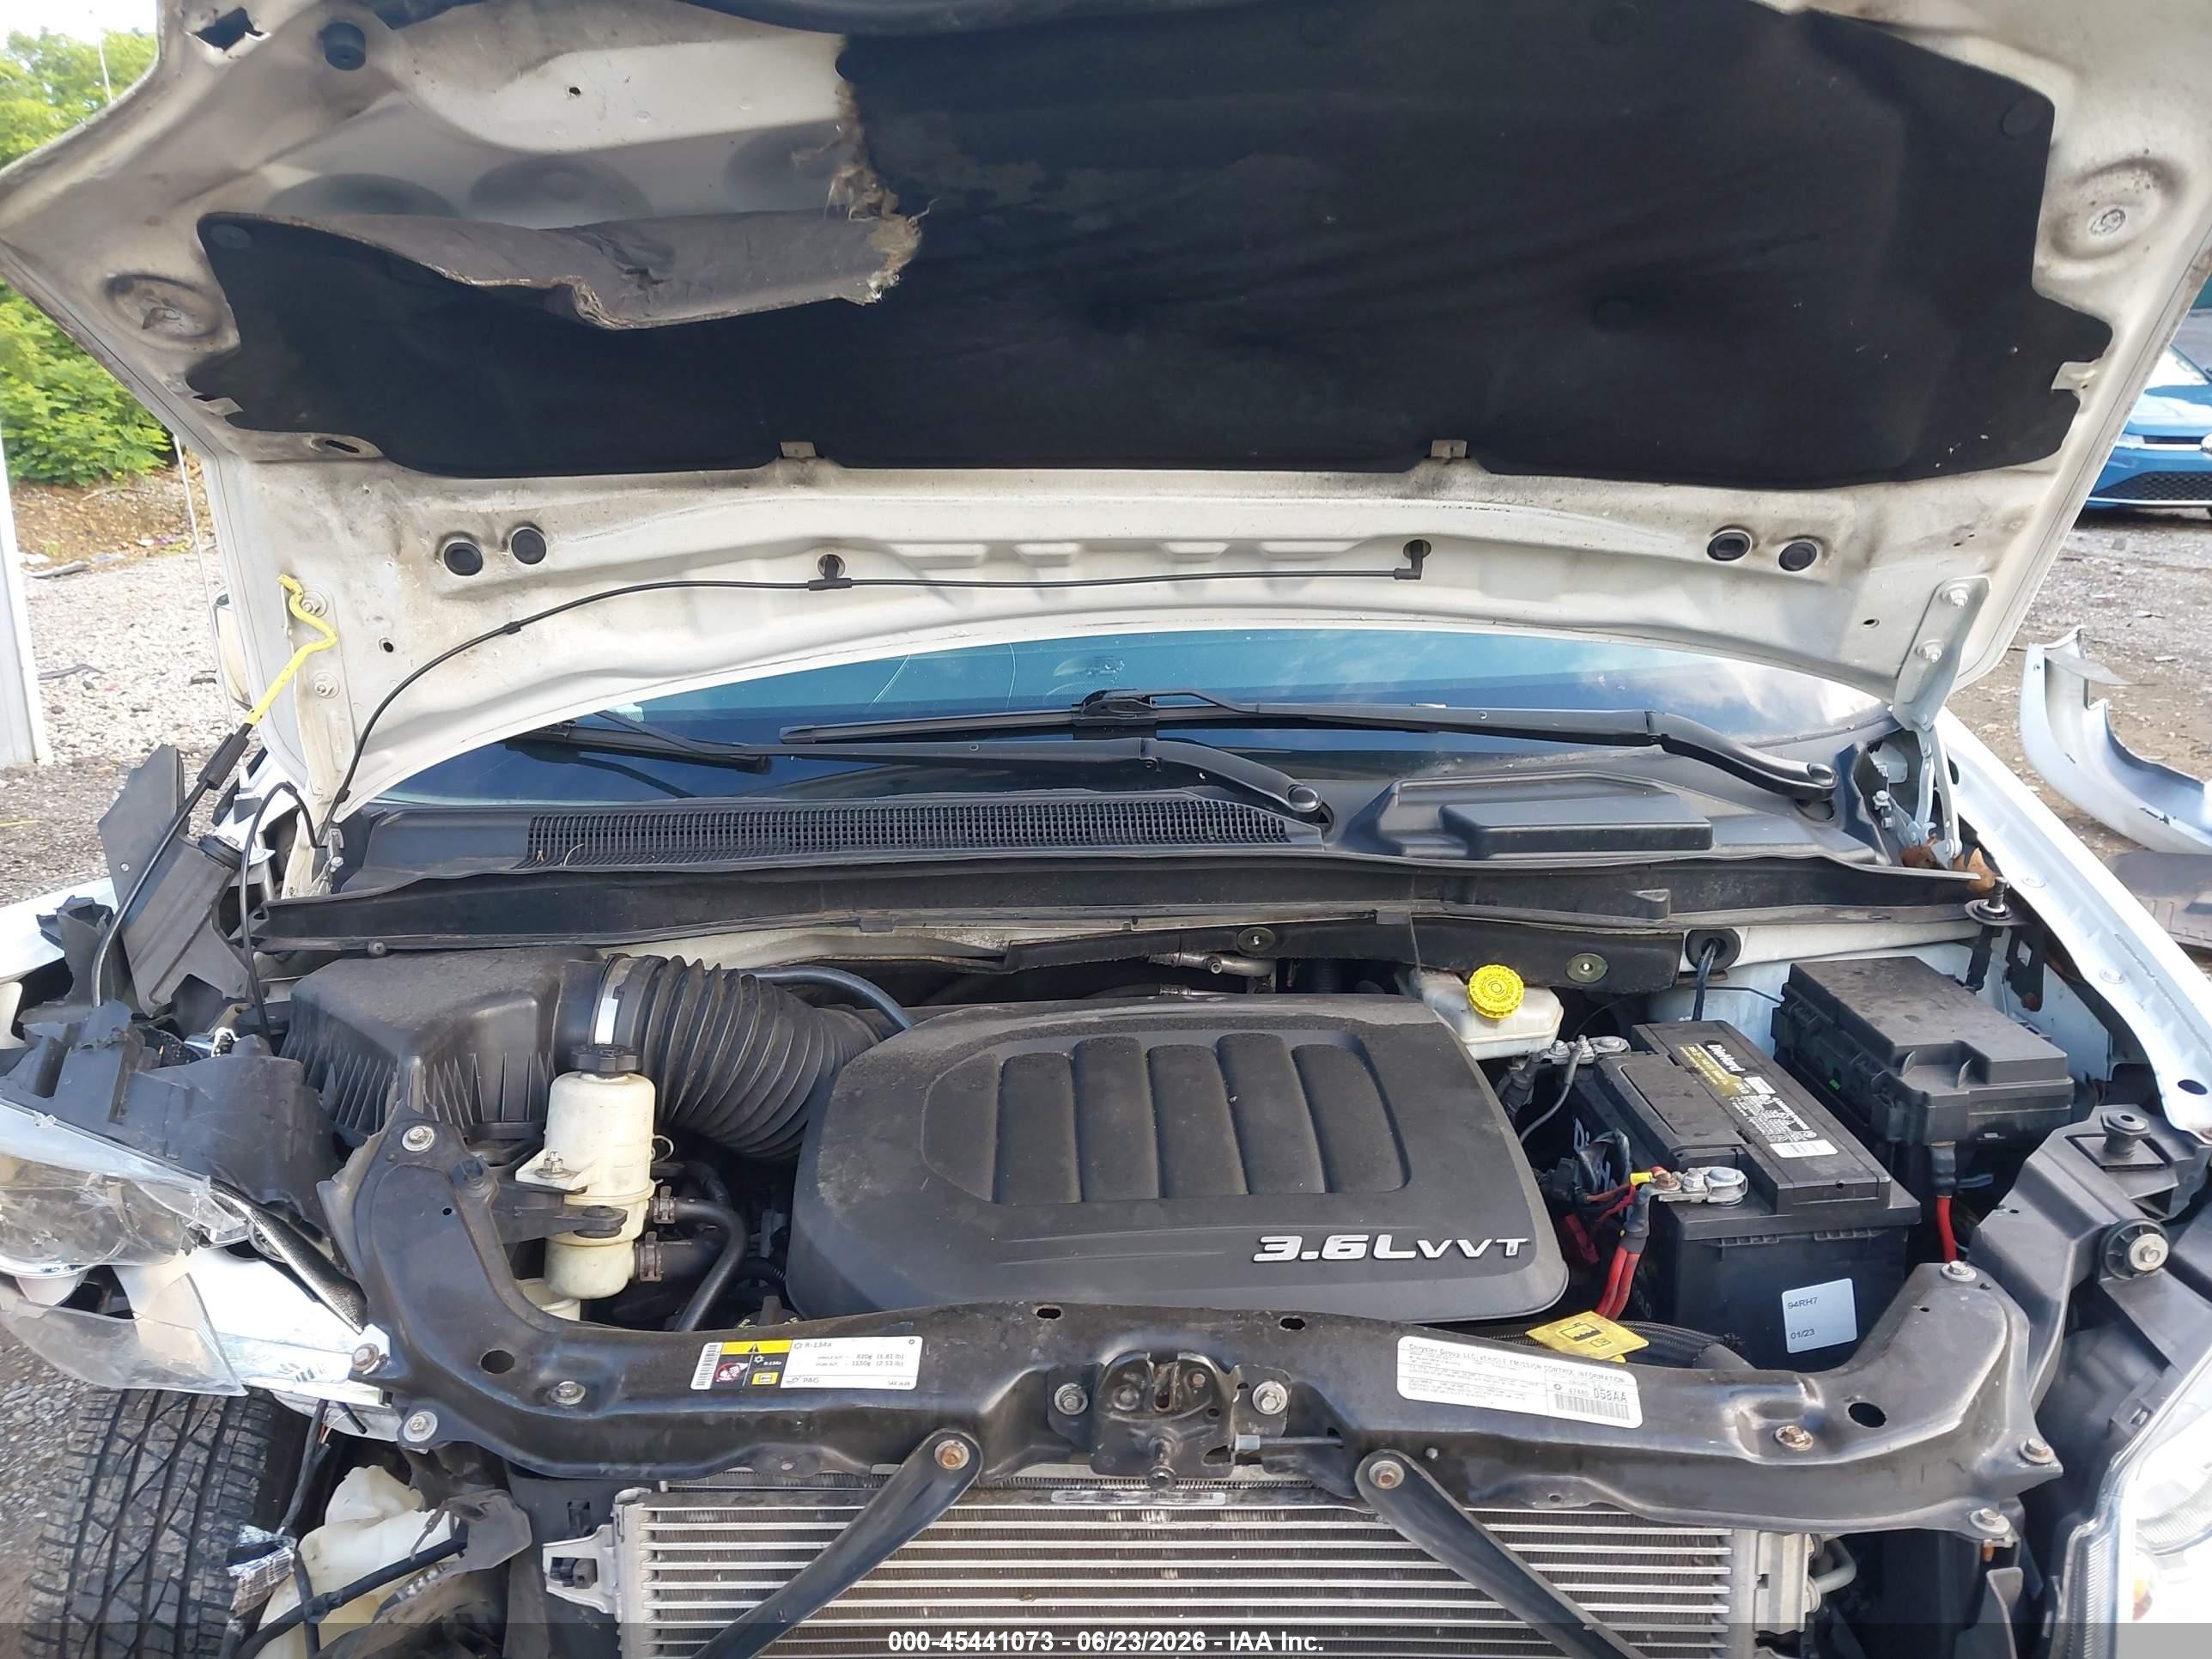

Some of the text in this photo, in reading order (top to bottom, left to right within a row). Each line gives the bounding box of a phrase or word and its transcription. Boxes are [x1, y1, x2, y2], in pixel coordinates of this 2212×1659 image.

[1707, 1044, 1746, 1072] DieHard
[1790, 1328, 1815, 1340] 01/23
[1409, 1344, 1438, 1355] Chrysler
[1440, 1348, 1460, 1358] Group
[1510, 1359, 1542, 1370] EMISSION
[1545, 1365, 1574, 1376] CONTROL
[1578, 1371, 1626, 1383] INFORMATION
